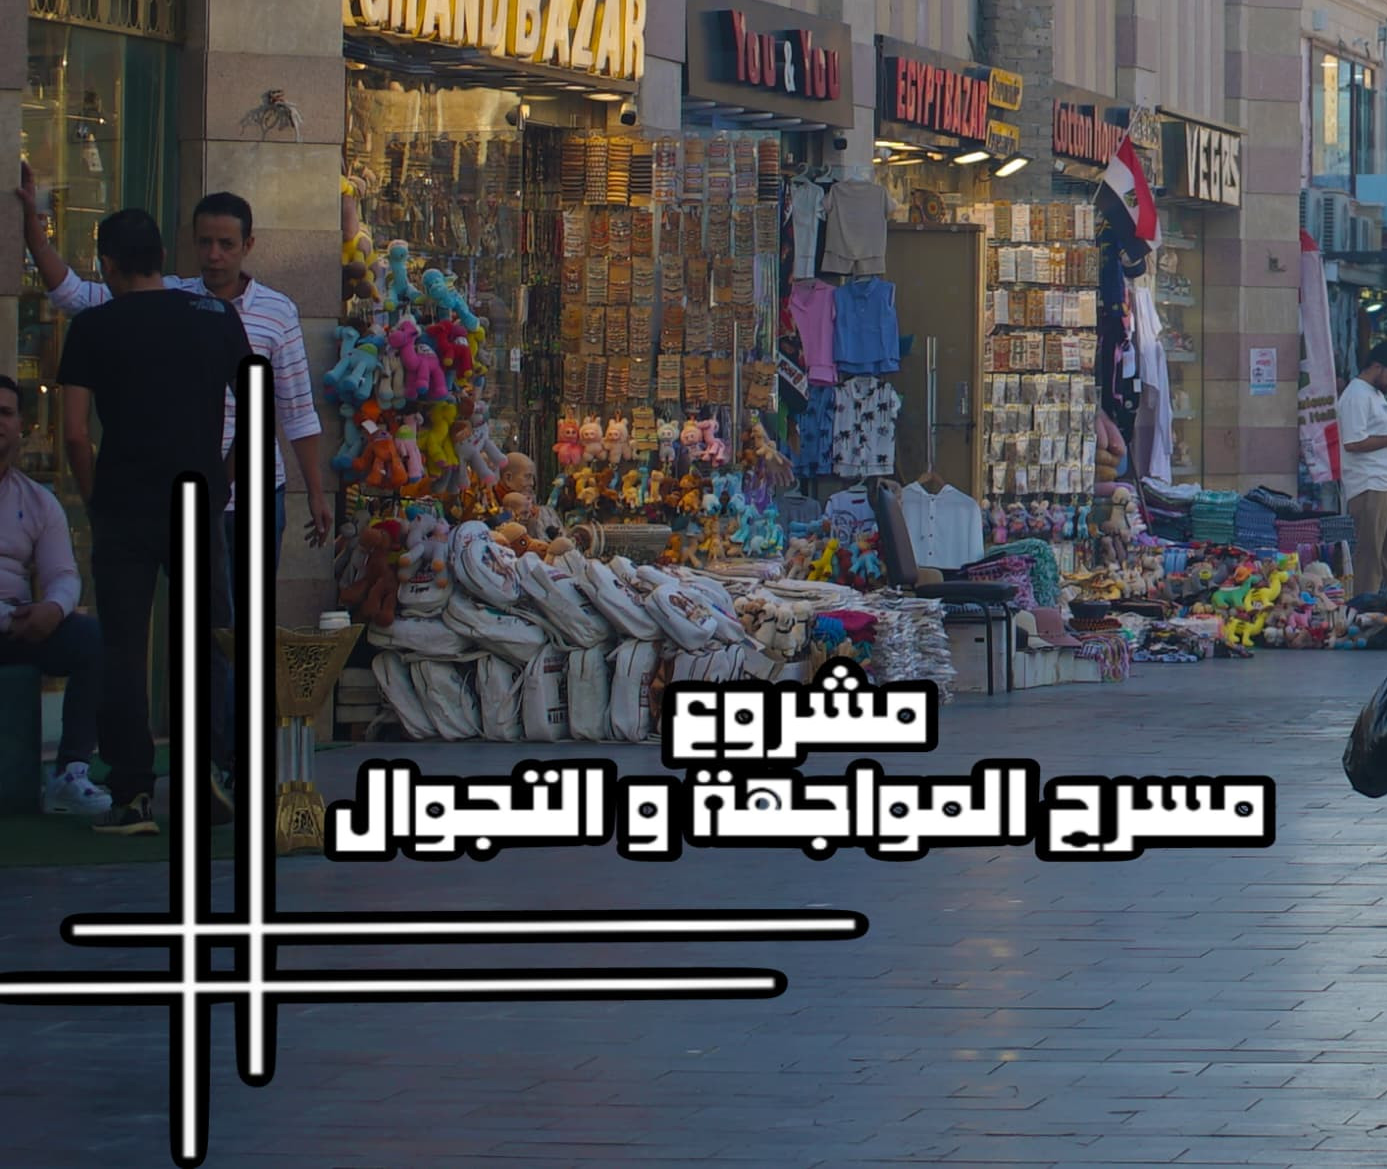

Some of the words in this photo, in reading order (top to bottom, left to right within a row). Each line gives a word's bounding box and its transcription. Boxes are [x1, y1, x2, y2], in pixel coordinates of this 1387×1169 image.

[784, 40, 797, 93] &
[896, 56, 944, 131] EGYPT
[943, 69, 988, 141] BAZAR
